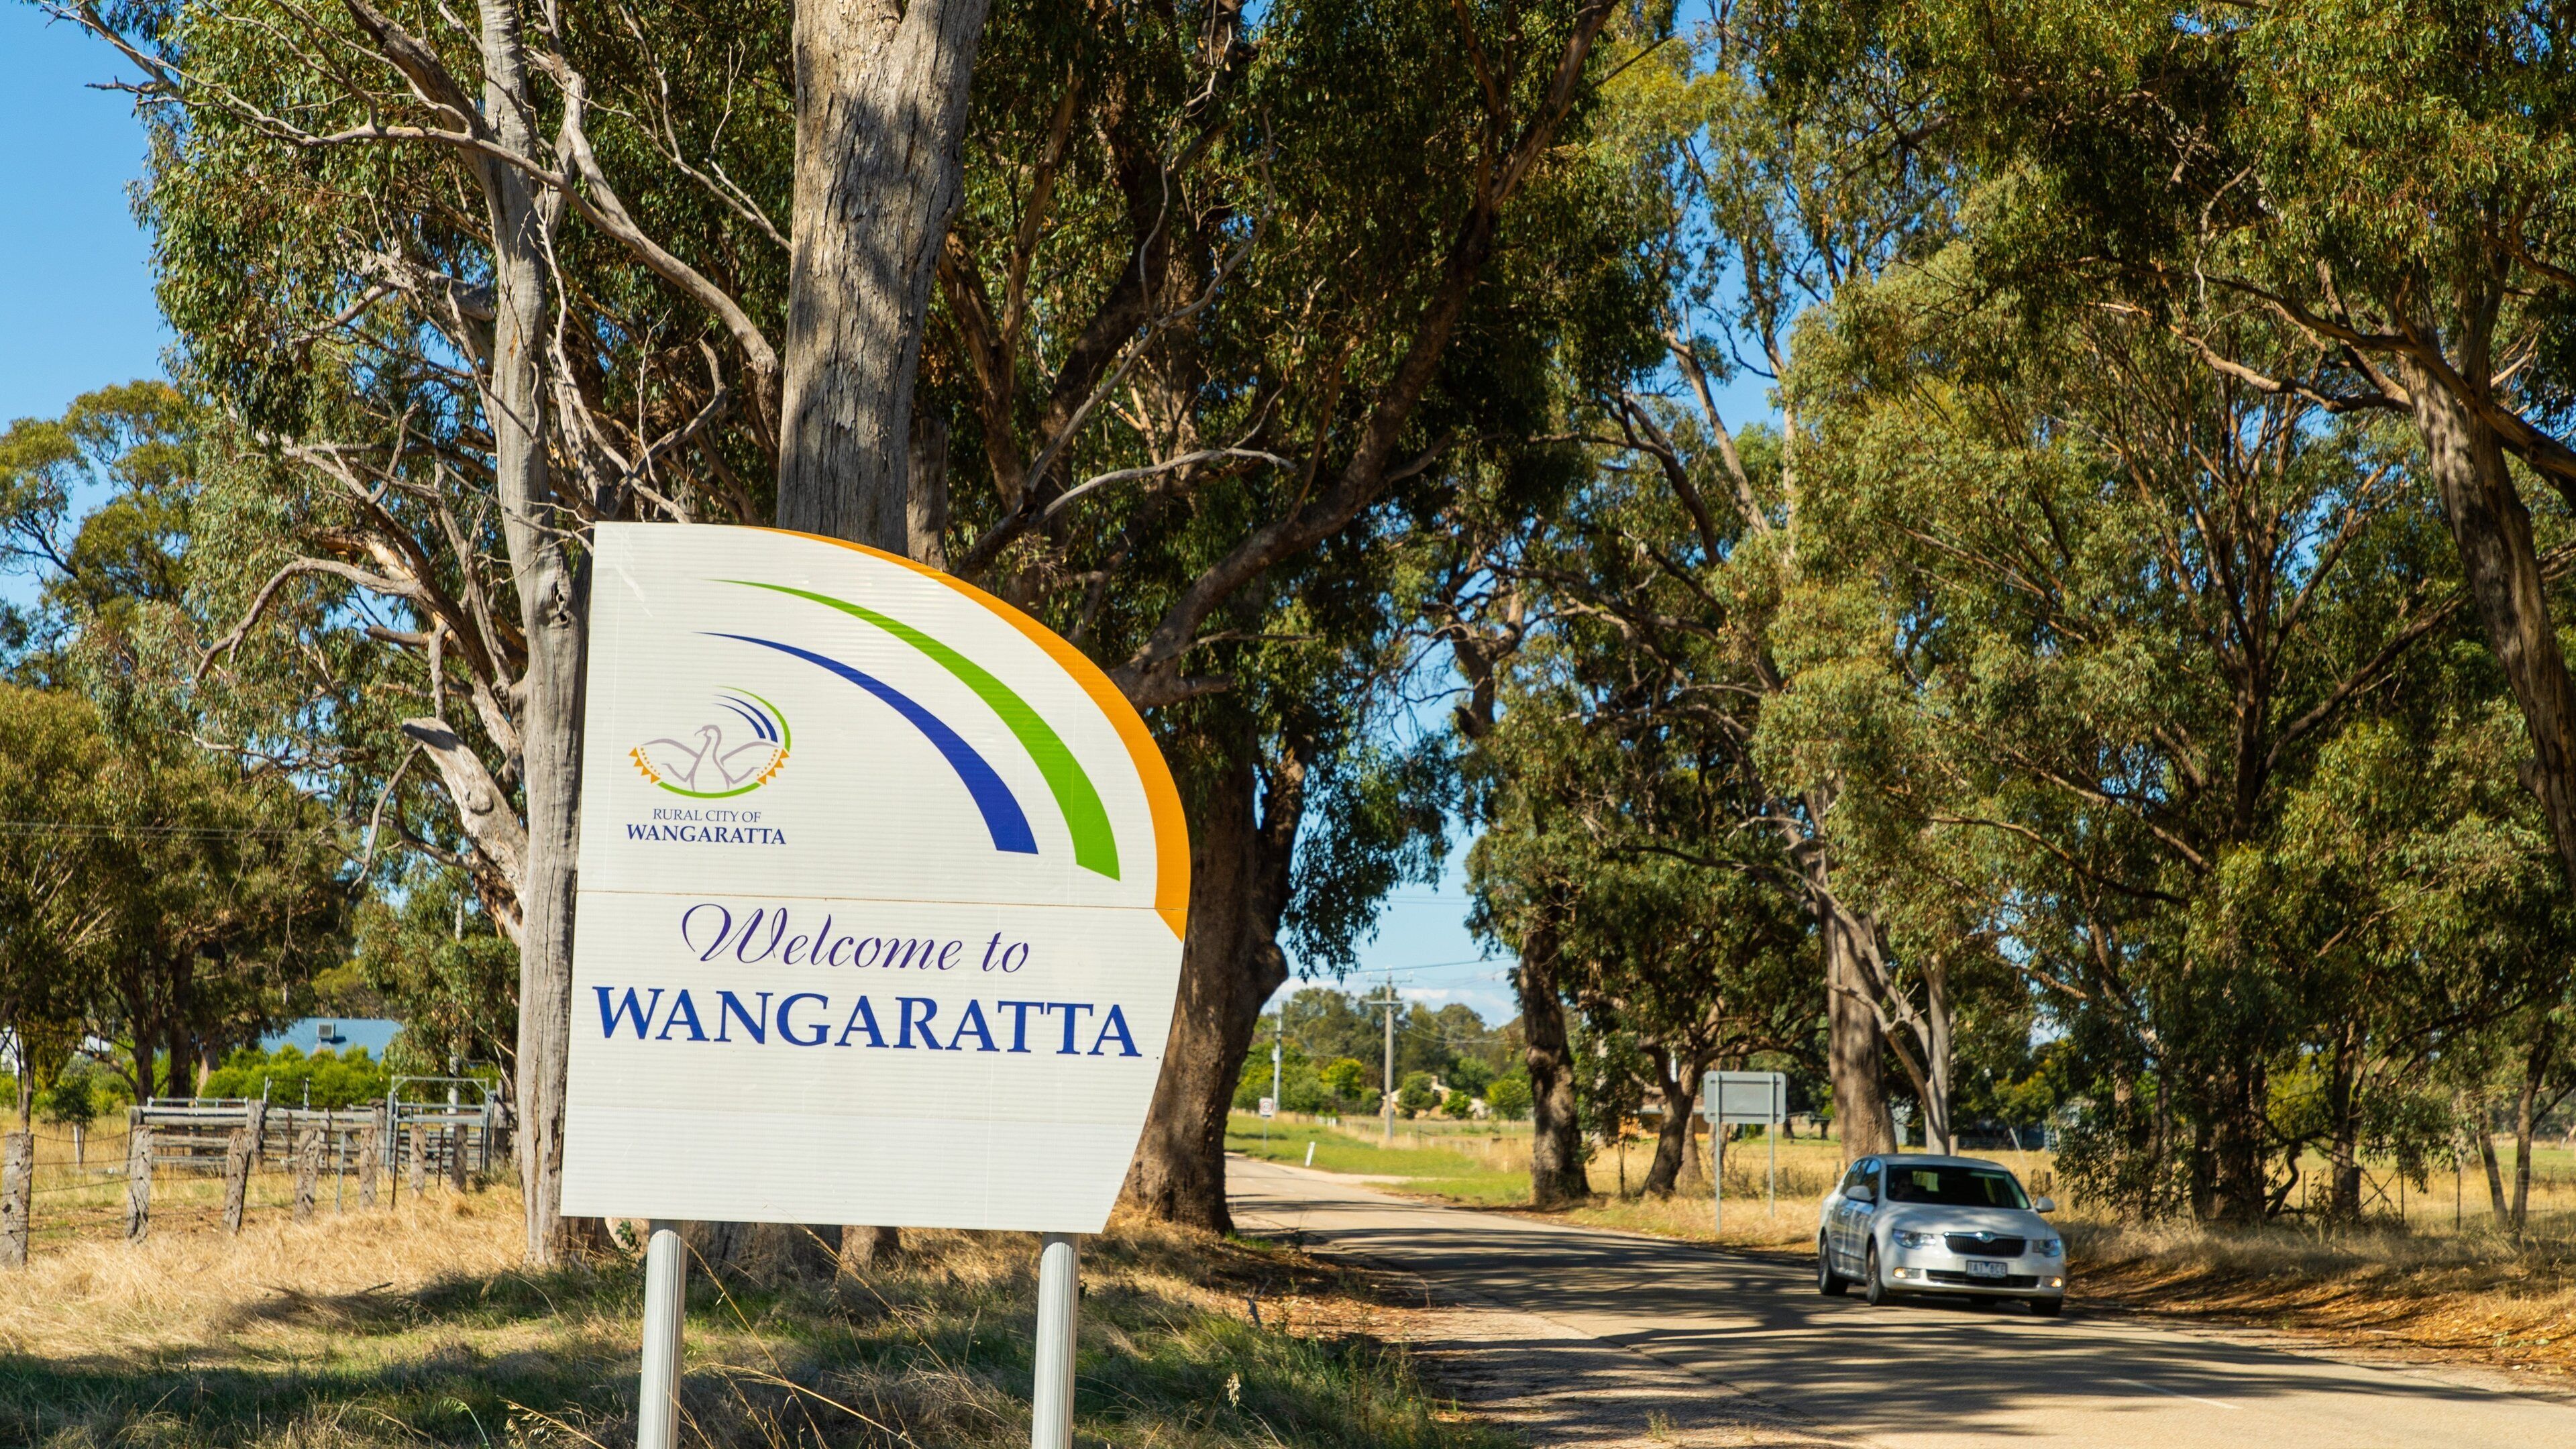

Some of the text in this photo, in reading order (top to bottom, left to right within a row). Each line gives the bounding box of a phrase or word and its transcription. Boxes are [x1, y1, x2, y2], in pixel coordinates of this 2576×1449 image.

[626, 824, 787, 845] WANGARATTA
[653, 808, 761, 823] RURAL CITY OF
[682, 904, 1029, 973] Welcome to
[592, 985, 1143, 1058] WANGARATTA
